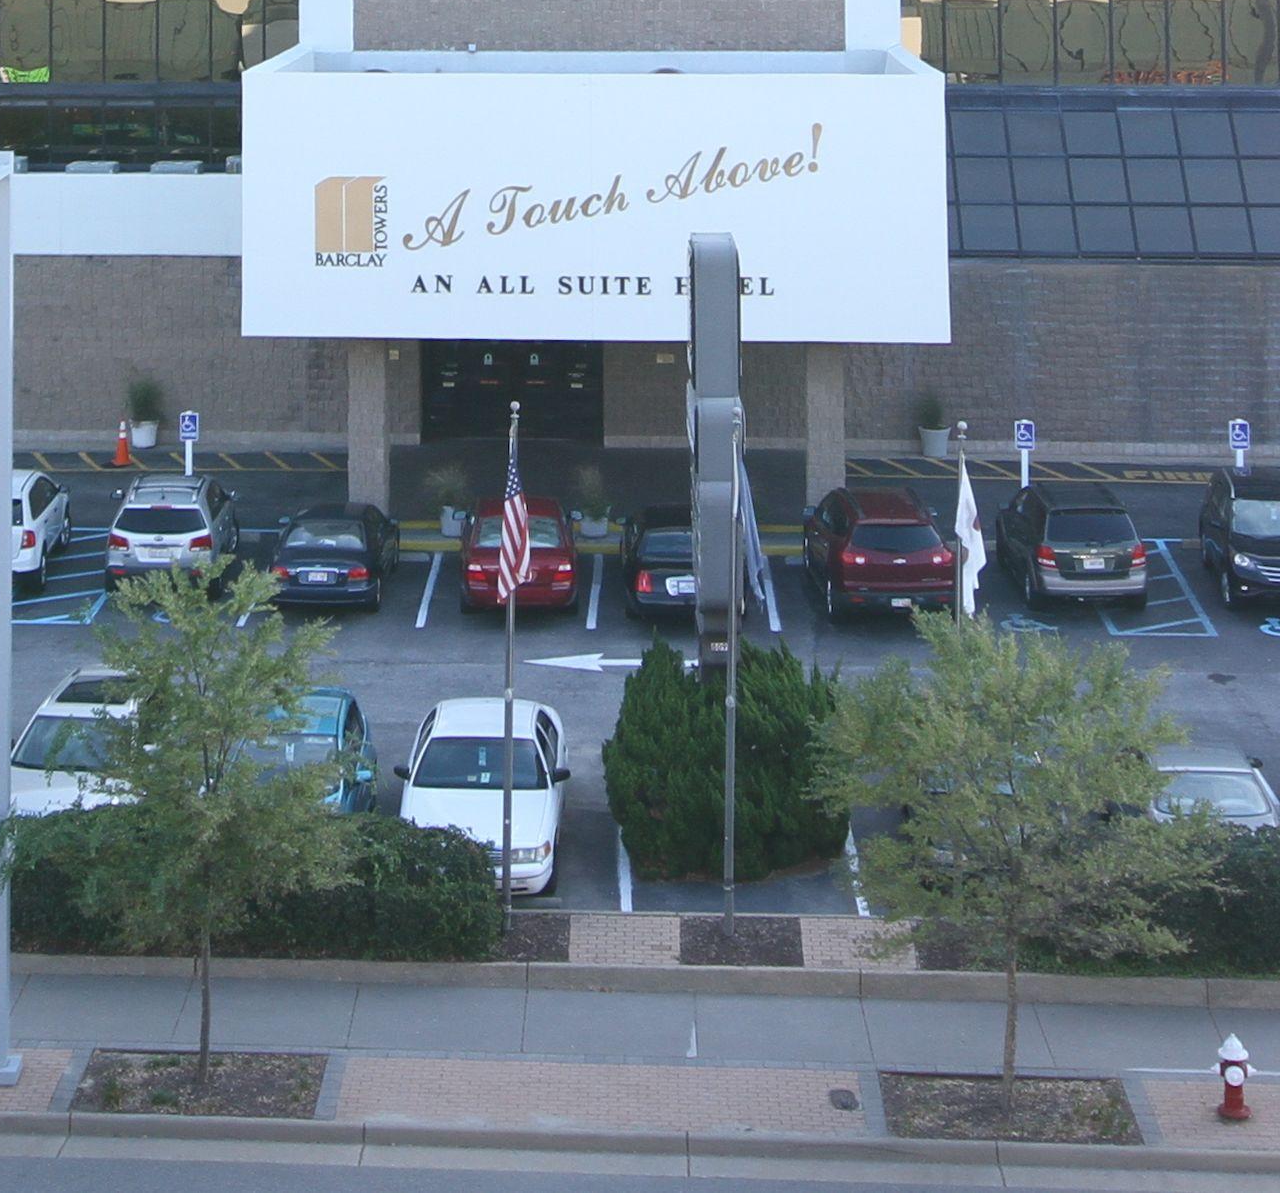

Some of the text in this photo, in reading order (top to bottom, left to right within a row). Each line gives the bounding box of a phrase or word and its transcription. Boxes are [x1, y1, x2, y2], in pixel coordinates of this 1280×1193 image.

[402, 122, 823, 251] A Touch Above!
[374, 184, 388, 251] TOWERS
[315, 253, 387, 267] BARCLAY
[411, 275, 776, 296] AN ALL SUITE HEL
